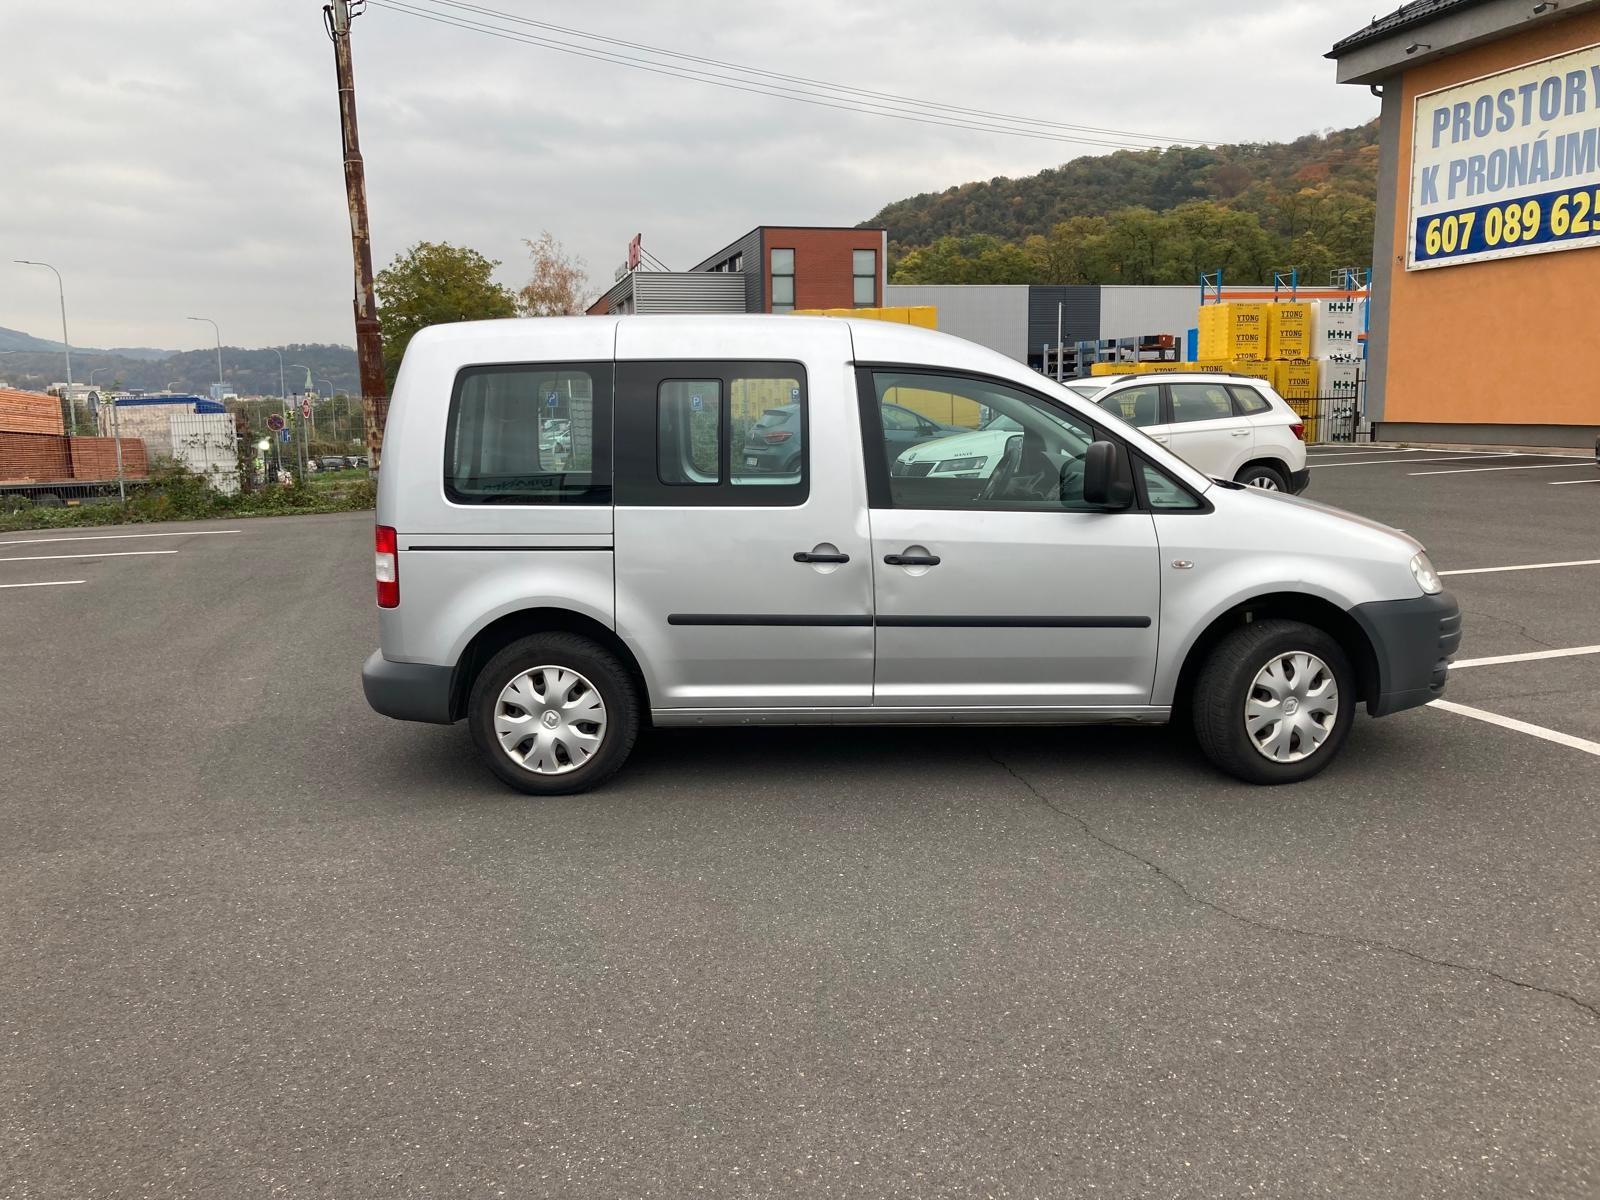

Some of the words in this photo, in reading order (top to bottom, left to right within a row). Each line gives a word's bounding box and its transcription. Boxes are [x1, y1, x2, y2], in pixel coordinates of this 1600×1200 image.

[1421, 165, 1439, 206] K
[1447, 127, 1600, 200] PRONÁJM
[1425, 212, 1476, 256] 607
[1484, 200, 1541, 246] 089
[1236, 314, 1259, 322] YTONG
[1281, 310, 1303, 318] YTONG
